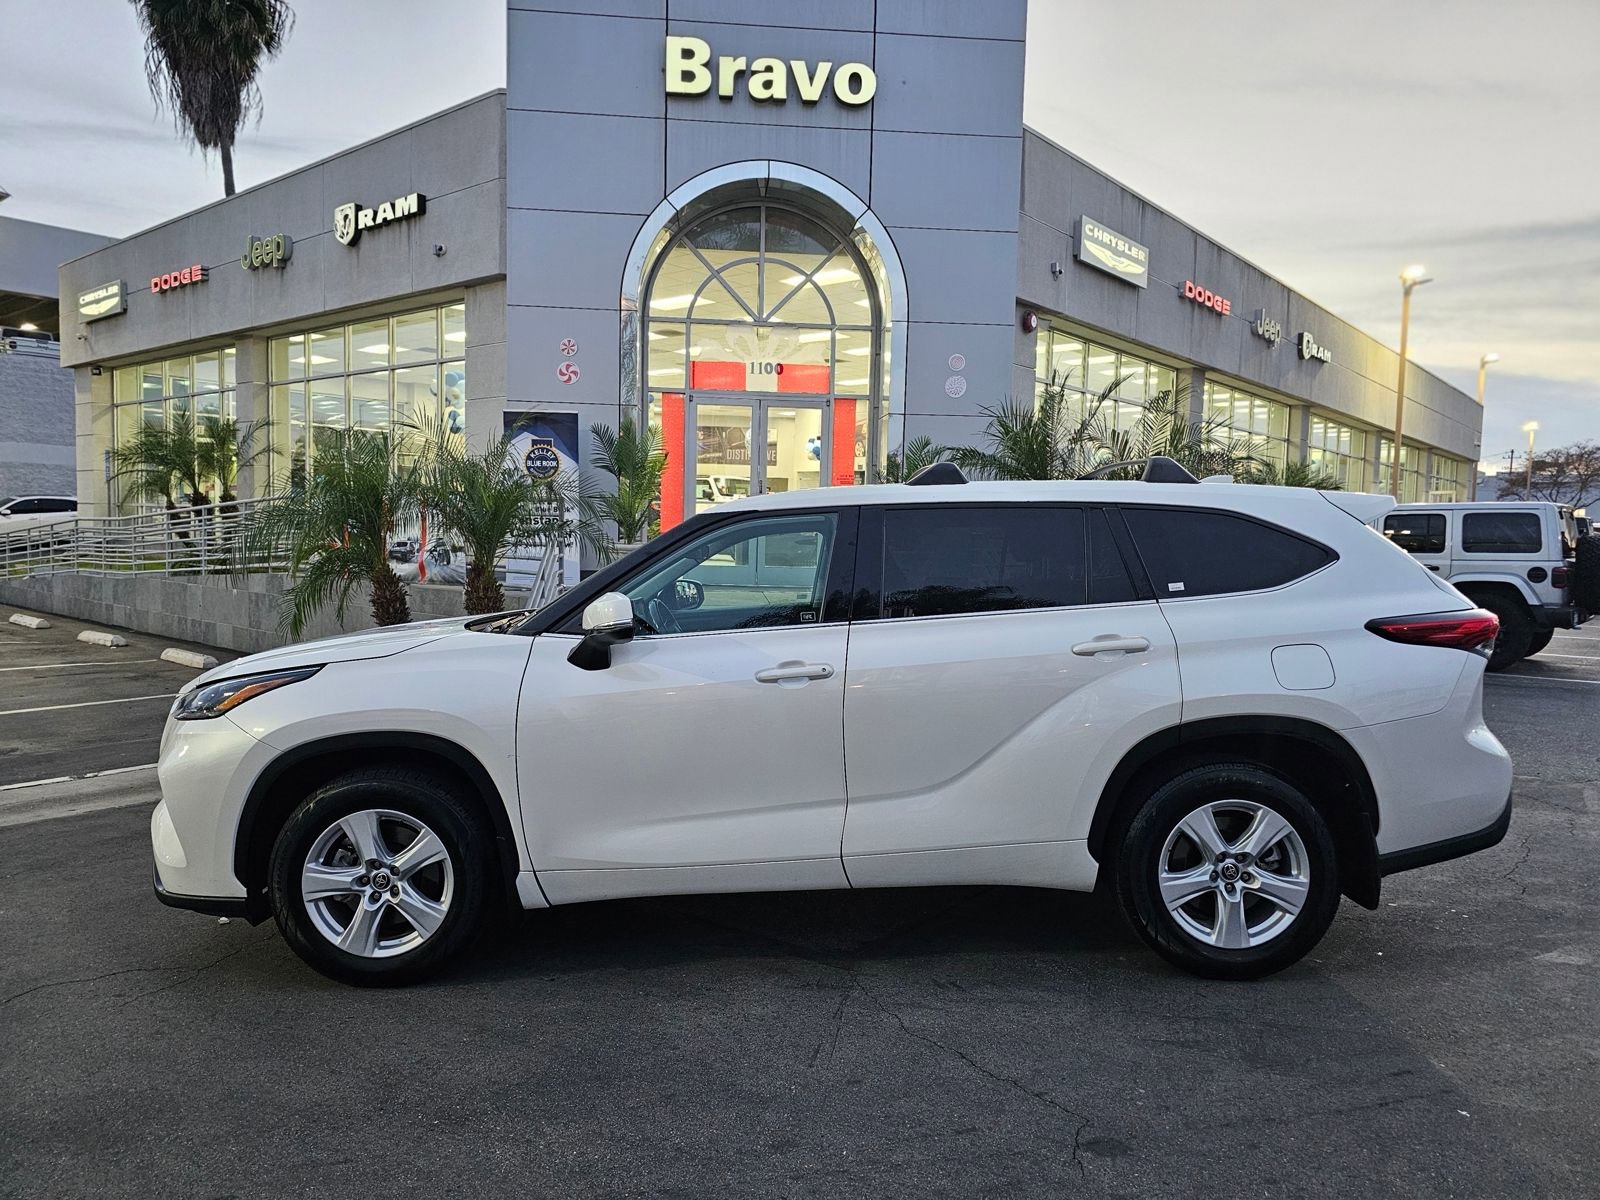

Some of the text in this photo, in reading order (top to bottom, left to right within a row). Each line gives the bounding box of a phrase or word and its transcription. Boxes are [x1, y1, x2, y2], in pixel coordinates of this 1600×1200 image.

[665, 35, 877, 106] Bravo
[357, 192, 418, 230] RAM
[240, 233, 286, 270] Jeep
[1085, 224, 1146, 262] CHRYSLER
[79, 285, 119, 305] CHRYSLER
[151, 267, 203, 294] DODGE
[1185, 280, 1231, 316] DODGE
[1257, 307, 1281, 349] Jeep
[750, 361, 784, 376] 1100
[1311, 343, 1332, 363] RAM
[530, 449, 555, 459] KELLEY
